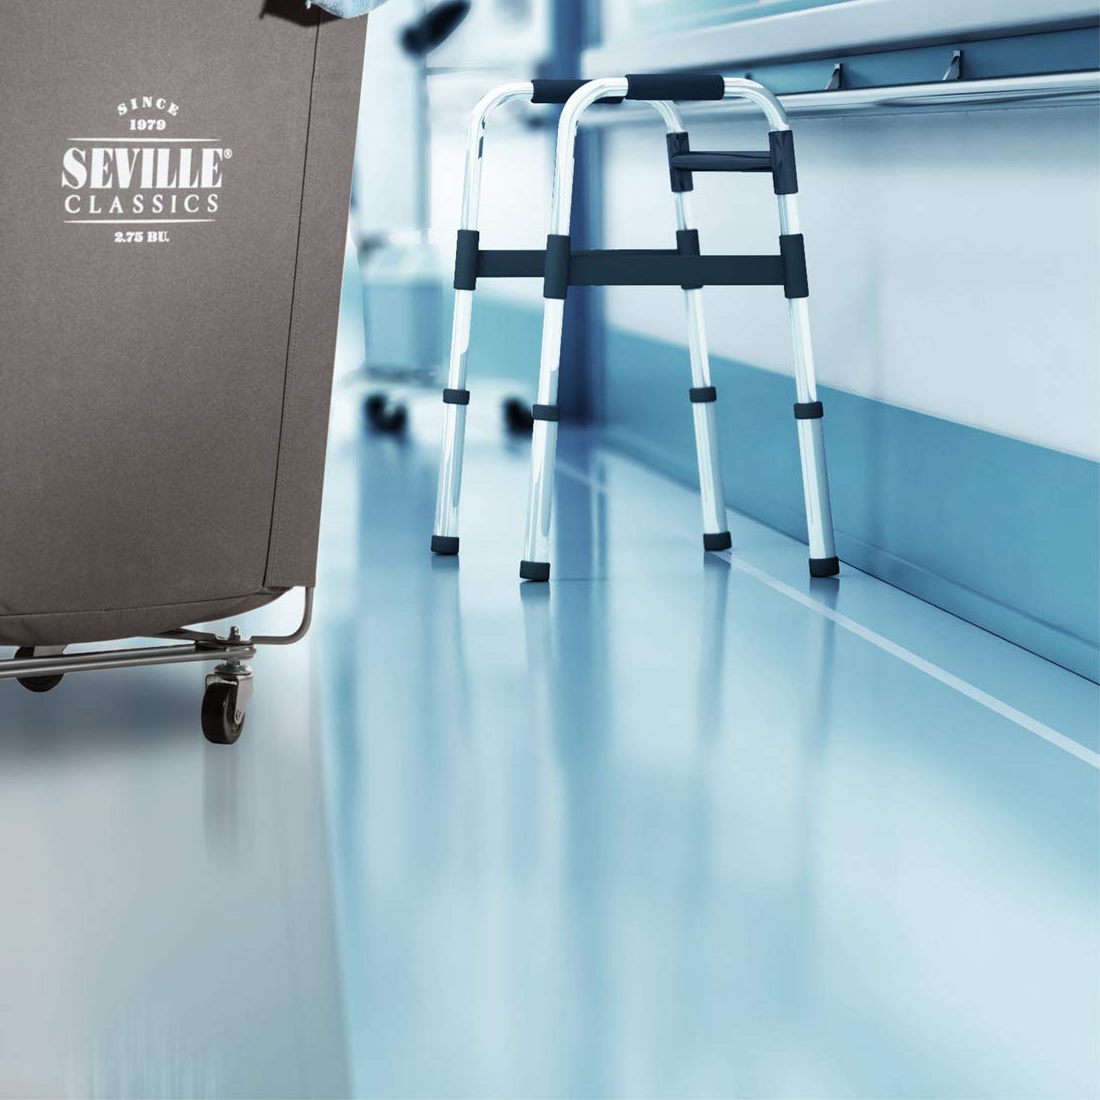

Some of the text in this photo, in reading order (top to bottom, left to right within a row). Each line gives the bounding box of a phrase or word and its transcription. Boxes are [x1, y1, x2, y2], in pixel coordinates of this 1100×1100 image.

[117, 96, 180, 116] SINCE
[129, 119, 167, 131] 1979
[64, 194, 219, 214] CLASSICS
[114, 231, 170, 243] 2.75 BU.
